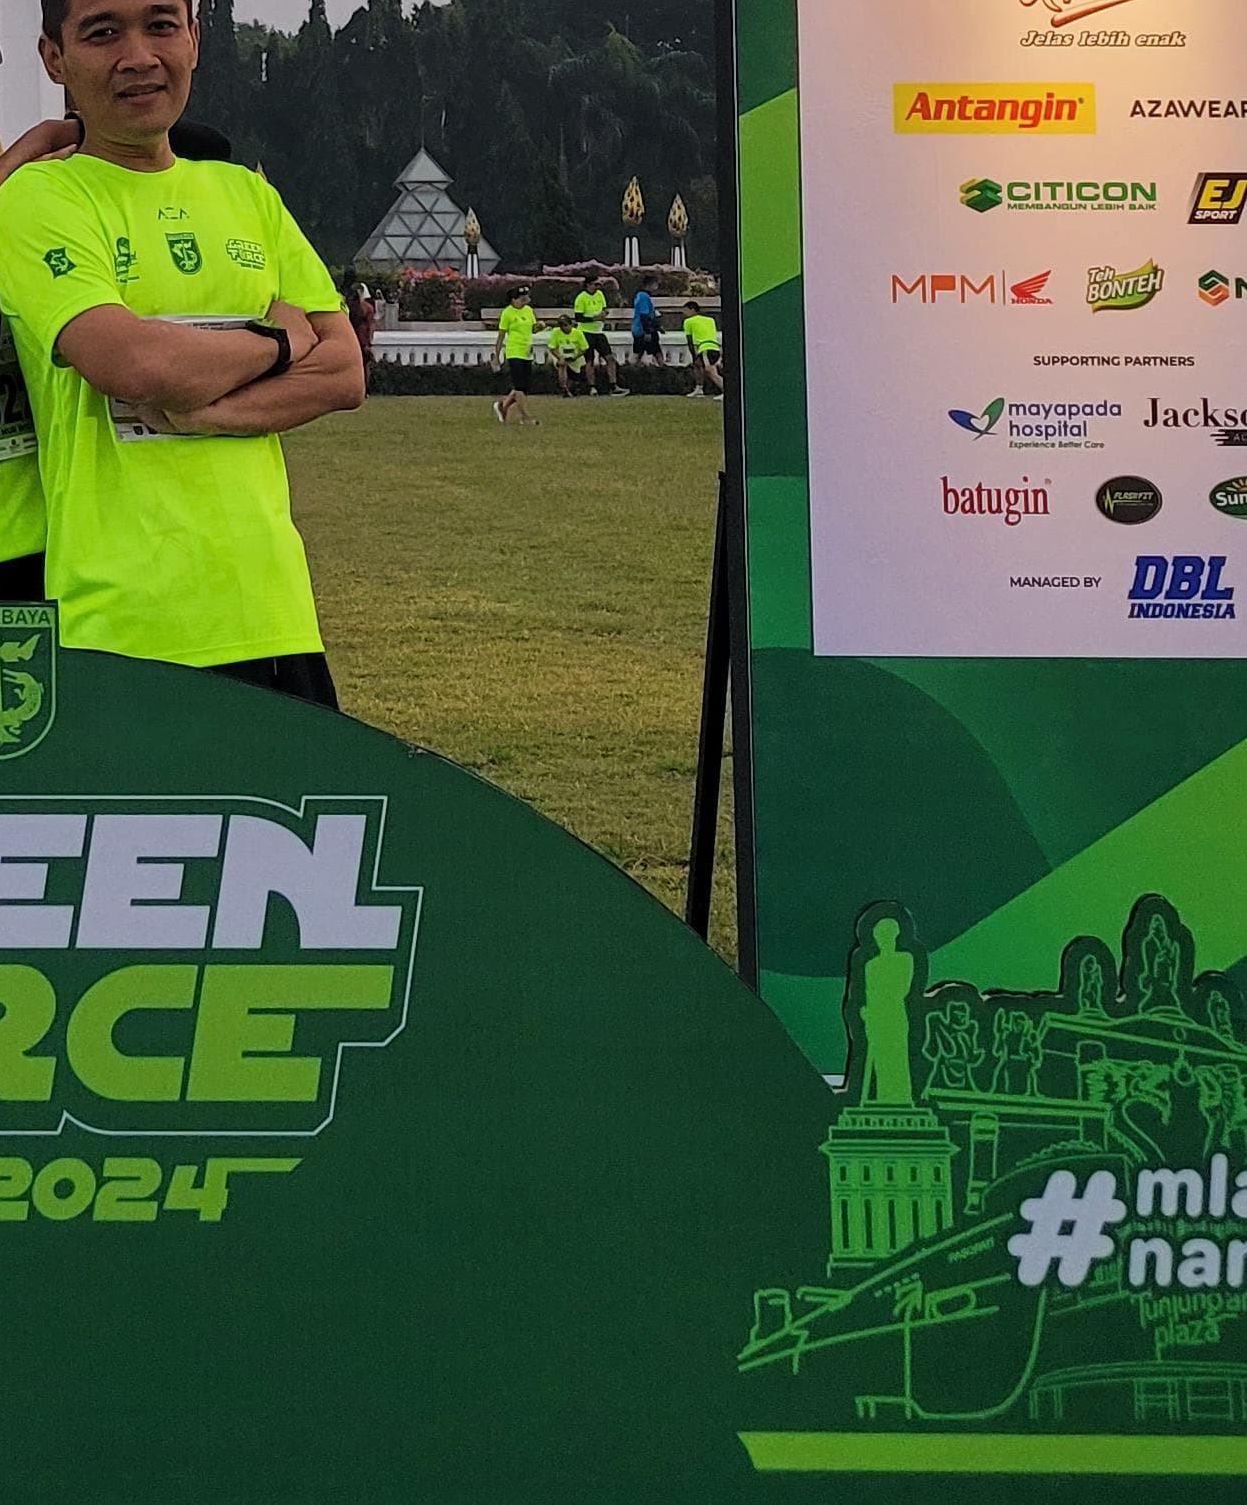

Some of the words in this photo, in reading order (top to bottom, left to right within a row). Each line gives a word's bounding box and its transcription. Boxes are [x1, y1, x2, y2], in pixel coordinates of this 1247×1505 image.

[1020, 30, 1074, 46] Jelas
[1077, 31, 1130, 46] lebih
[1135, 31, 1186, 46] enak
[905, 91, 1078, 129] Antangin
[1006, 181, 1157, 202] CITICON
[1197, 179, 1247, 209] EJ
[1007, 203, 1086, 211] MEMBANGUN
[1091, 203, 1125, 211] LEBIH
[1129, 203, 1157, 211] BAIK
[1194, 210, 1238, 220] SPORT
[1087, 266, 1114, 284] Teh
[1086, 267, 1164, 303] BONTEH
[1033, 356, 1120, 367] SUPPORTING
[1124, 356, 1195, 367] PARTNERS
[1008, 400, 1122, 420] mayapada
[1008, 421, 1088, 440] hospital
[940, 475, 1051, 526] batugin
[1009, 576, 1080, 588] MANAGED
[1083, 576, 1102, 588] BY
[1127, 555, 1234, 600] DBL
[1128, 603, 1235, 619] INDONESIA
